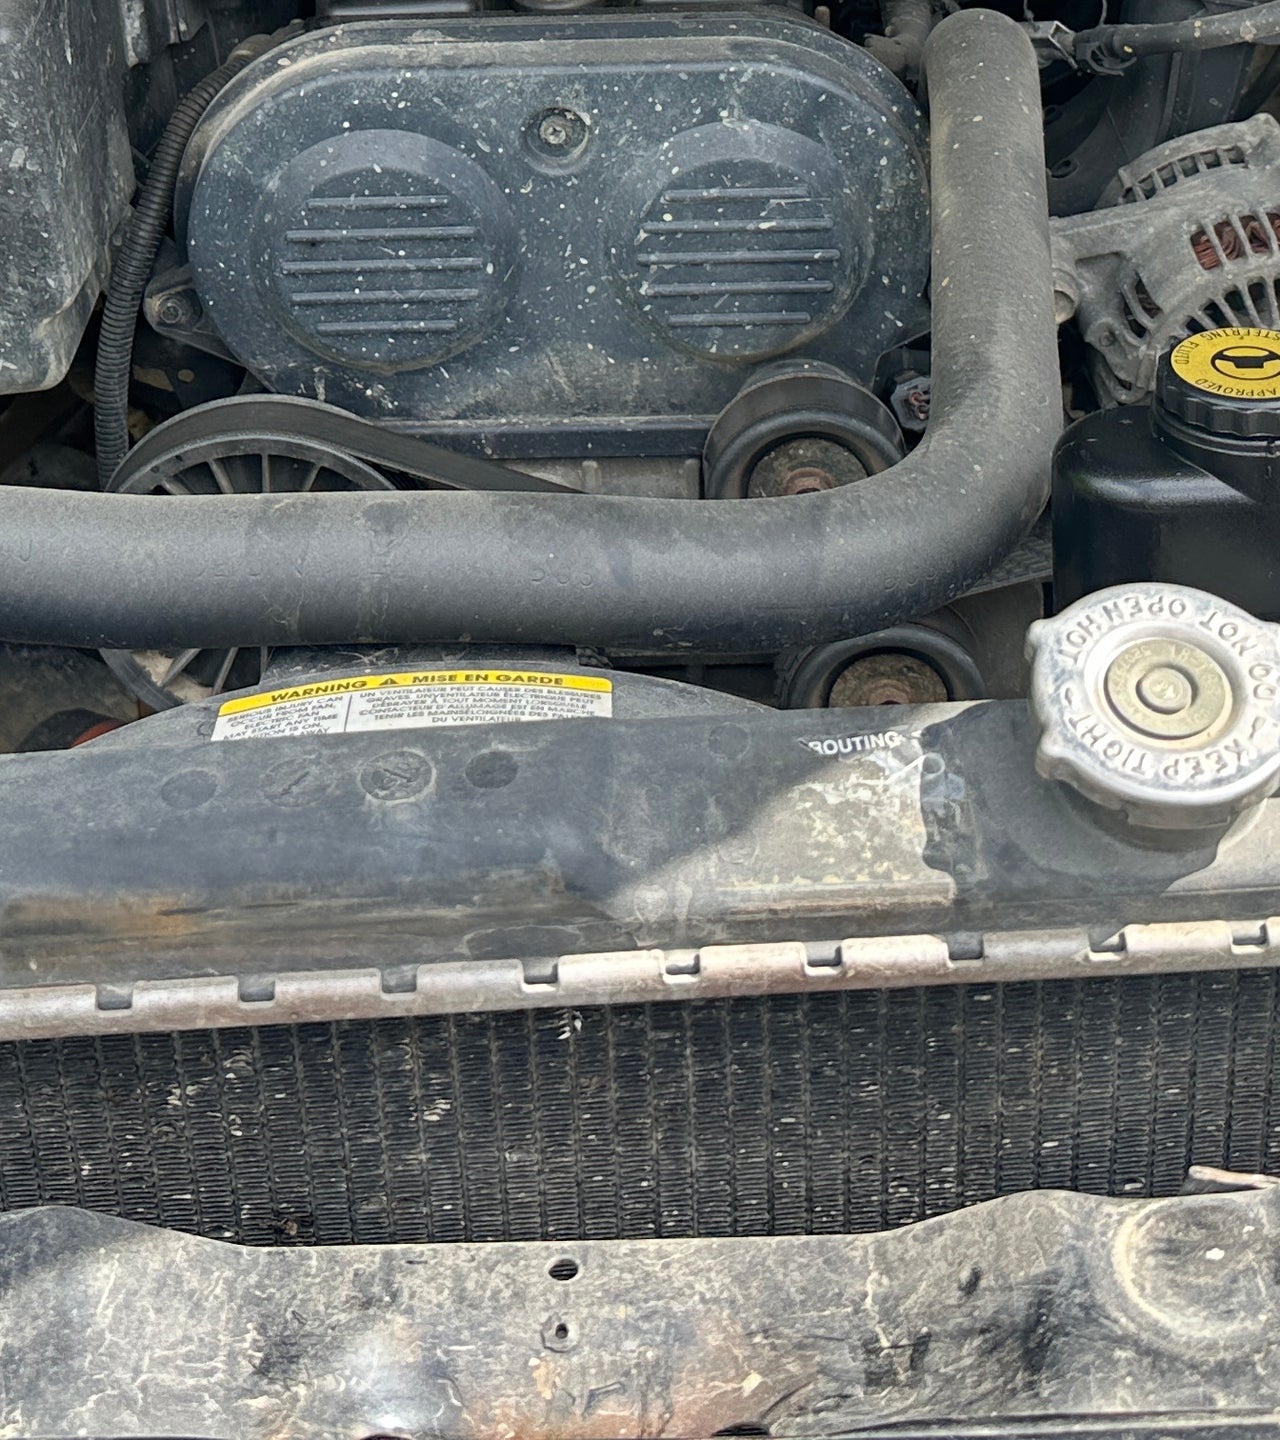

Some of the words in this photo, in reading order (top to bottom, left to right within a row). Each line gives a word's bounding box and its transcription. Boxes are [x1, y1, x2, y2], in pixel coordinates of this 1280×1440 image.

[1174, 340, 1200, 365] FLUID
[1194, 377, 1277, 397] APPROVED
[1101, 595, 1188, 624] OPEN
[1057, 613, 1103, 665] HOT
[1198, 610, 1259, 658] NOT
[270, 680, 368, 703] WARNING
[411, 674, 458, 684] MISE
[464, 673, 489, 682] EN
[495, 674, 564, 685] GARDE
[360, 691, 376, 699] UN
[379, 686, 448, 696] VENTILATEUR
[226, 707, 272, 723] SERIOUS
[274, 700, 314, 713] INJURY
[316, 695, 344, 705] CAN
[359, 705, 433, 716] CONTACTEUR
[569, 696, 595, 705] PEUT
[230, 713, 272, 727] OCCUR
[274, 707, 309, 718] FROM
[244, 716, 295, 730] ELECTRIC
[297, 710, 320, 720] FAN
[251, 723, 283, 736] START
[284, 718, 311, 728] ANY
[313, 713, 339, 723] TIME
[374, 712, 405, 721] TENIR
[407, 710, 425, 718] LES
[528, 710, 549, 718] DES
[431, 716, 448, 724] DU
[289, 725, 300, 733] IS
[1064, 712, 1151, 776] TIGHT
[1161, 737, 1252, 780] KEEP
